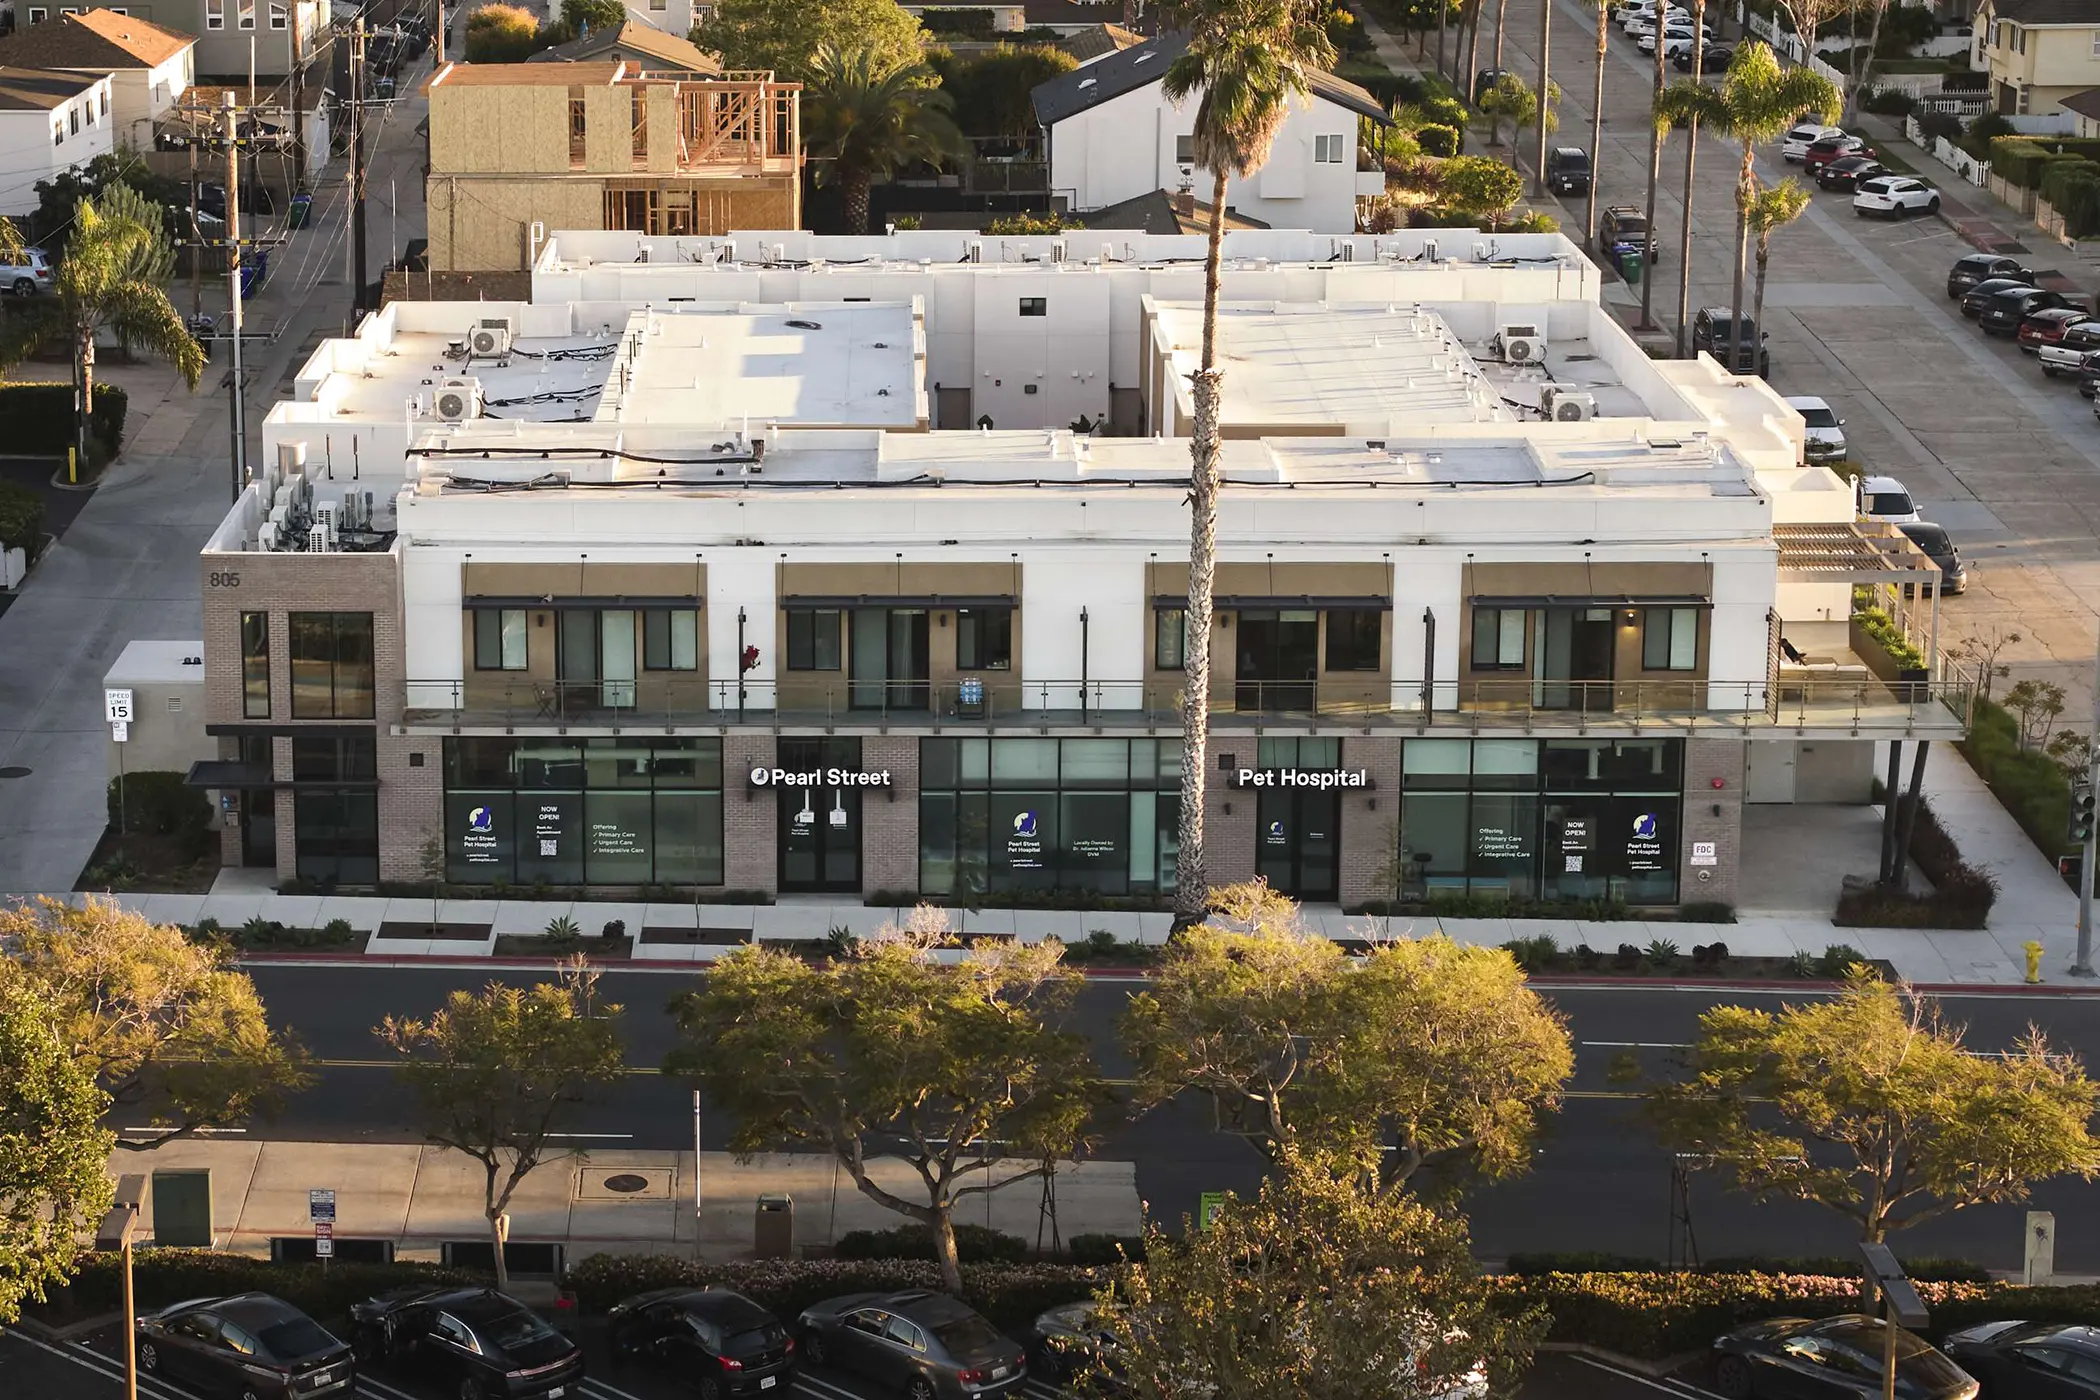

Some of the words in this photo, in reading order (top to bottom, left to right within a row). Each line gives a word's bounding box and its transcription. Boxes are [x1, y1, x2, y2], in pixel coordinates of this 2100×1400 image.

[210, 572, 240, 587] 805
[111, 706, 128, 718] 15
[771, 769, 821, 786] Pearl
[827, 768, 891, 786] Street
[1239, 769, 1275, 786] Pet
[1281, 769, 1366, 790] Hospital
[1696, 845, 1712, 854] FDC
